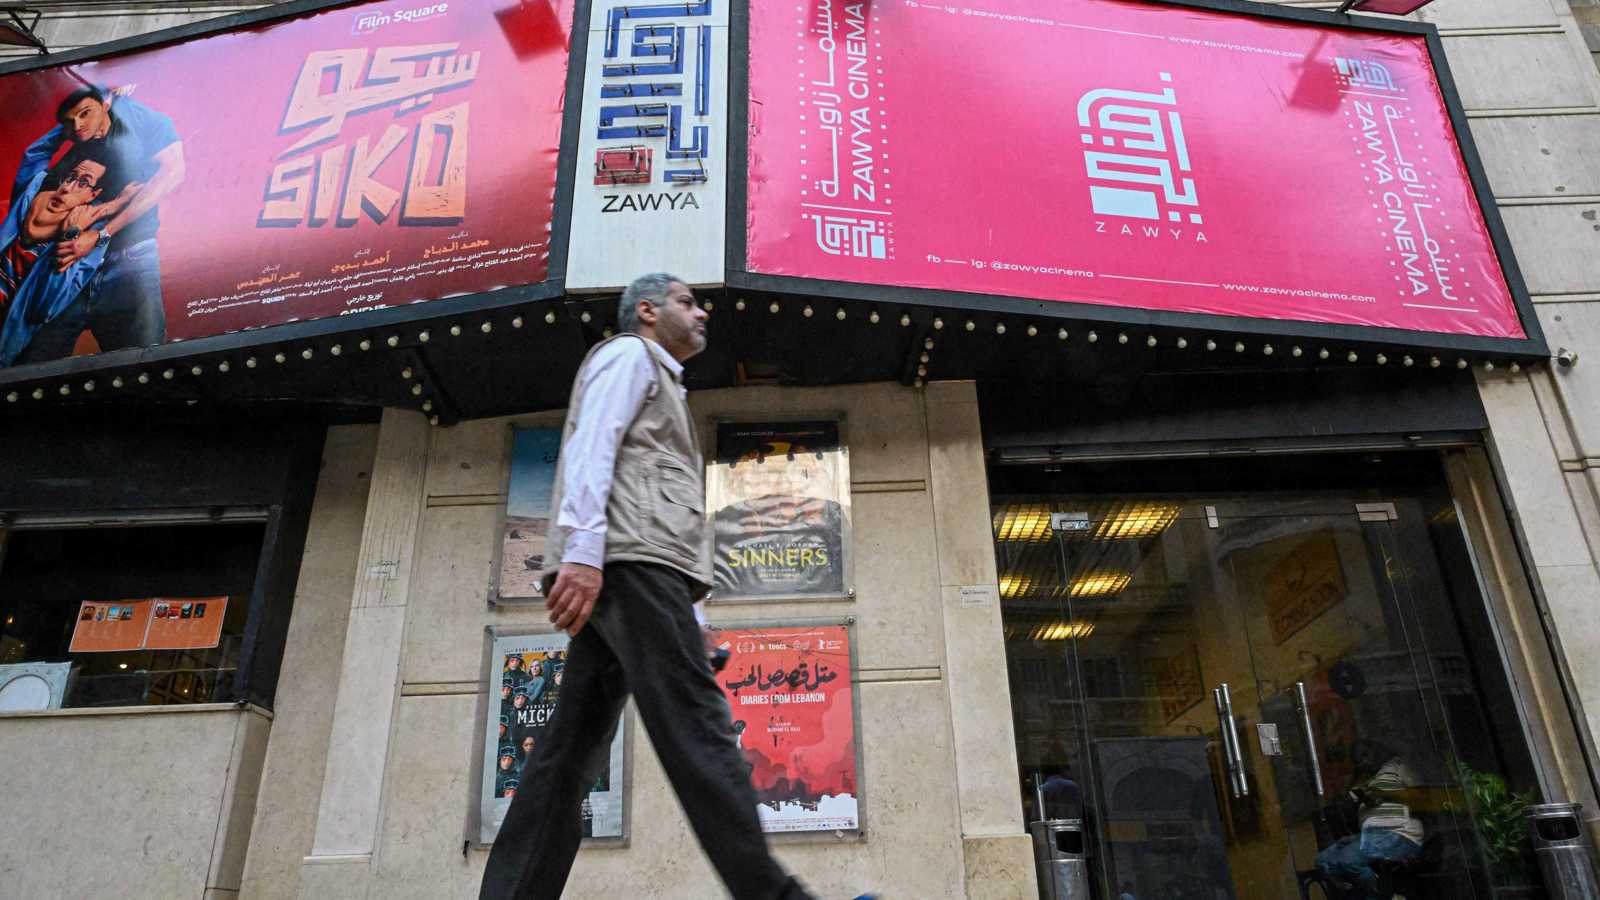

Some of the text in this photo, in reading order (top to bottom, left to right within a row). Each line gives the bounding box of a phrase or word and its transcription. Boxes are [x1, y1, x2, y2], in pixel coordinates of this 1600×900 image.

[358, 3, 449, 31] Film Square
[274, 42, 481, 161] سيكو
[844, 3, 876, 202] ZAWYA CINEMA
[257, 102, 469, 227] SIKO
[601, 192, 700, 213] ZAWYA
[1353, 100, 1429, 297] ZAWYA CINEMA
[462, 239, 491, 250] محمد
[1095, 221, 1208, 243] ZAWYA
[362, 251, 391, 267] أحمد
[925, 254, 941, 264] fb
[991, 260, 1094, 279] @zawyacinema
[1222, 283, 1377, 304] www.zawyacinema.com
[728, 549, 830, 568] SINNERS
[740, 694, 769, 705] DIARIES
[792, 692, 825, 704] LEBANON
